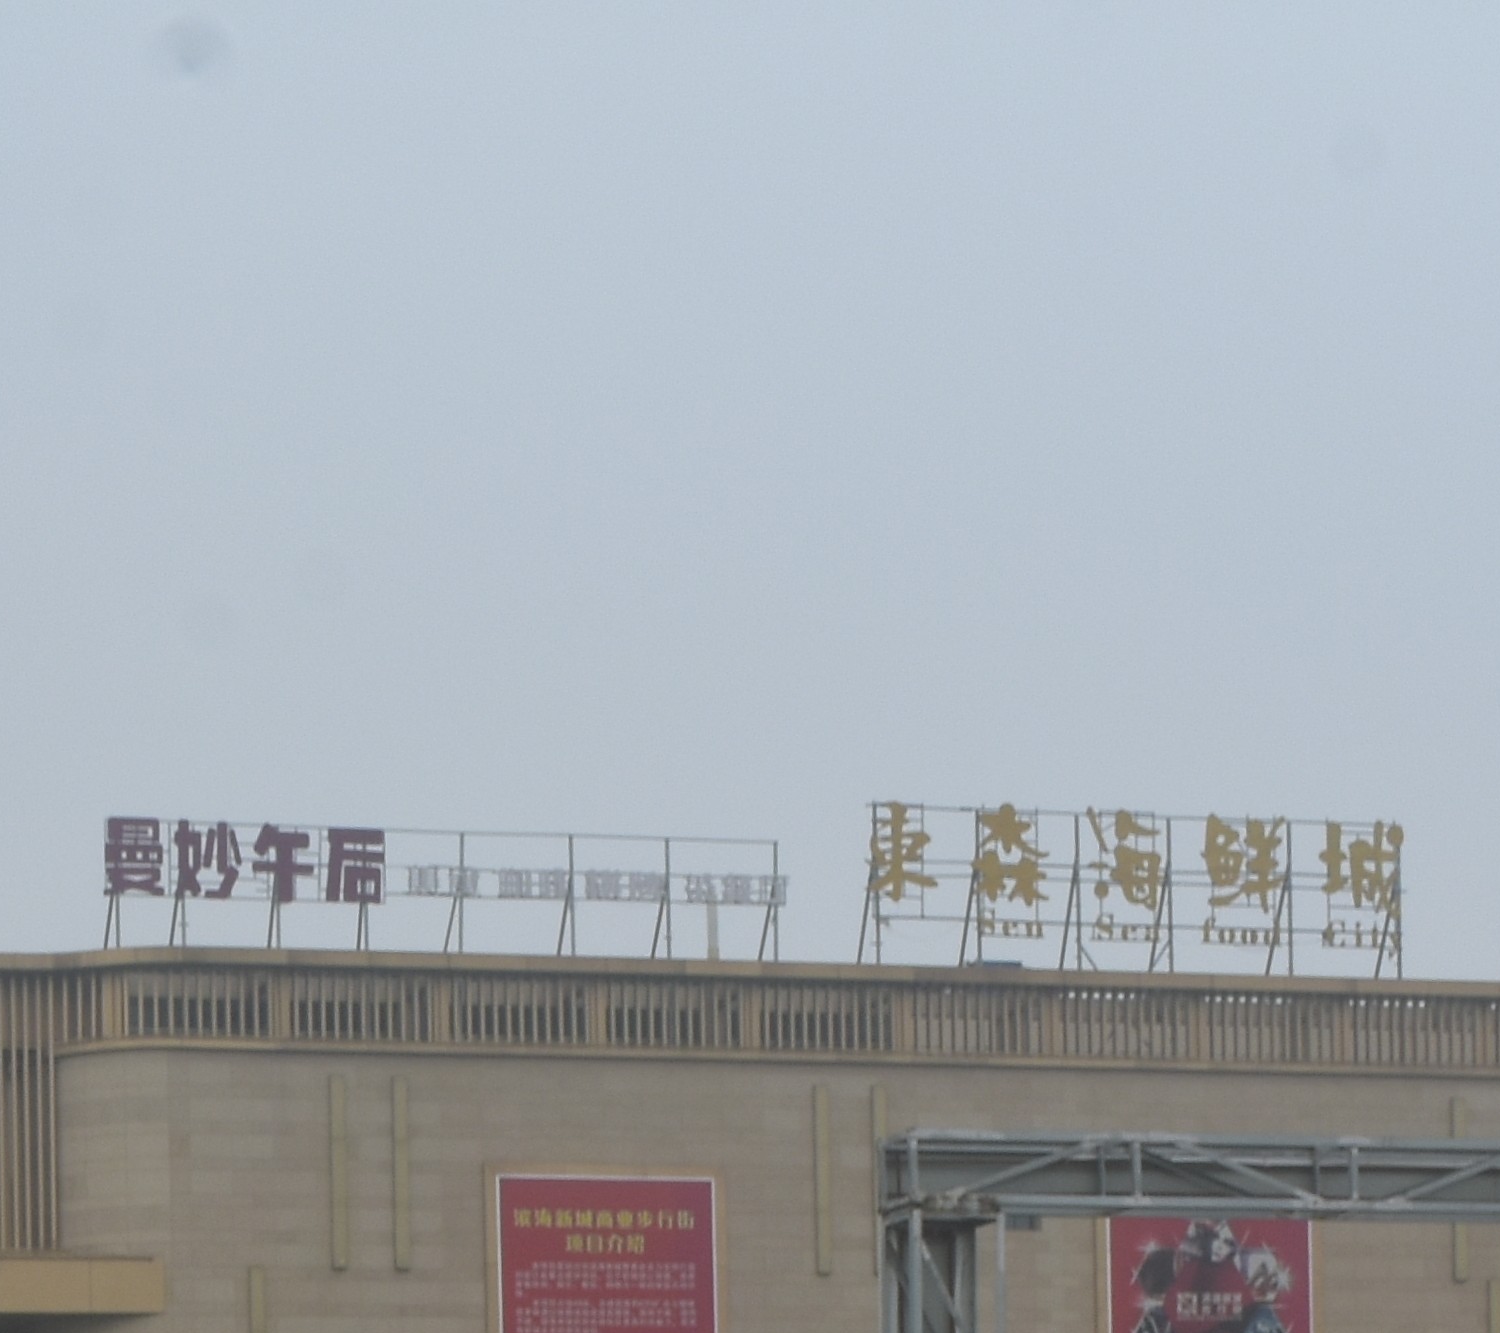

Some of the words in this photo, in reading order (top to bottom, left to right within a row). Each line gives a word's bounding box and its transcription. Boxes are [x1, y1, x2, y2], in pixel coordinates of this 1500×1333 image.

[103, 816, 386, 903] 曼妙午后
[1321, 919, 1400, 956] City
[513, 1207, 696, 1231] 滨海新城商业步行街
[565, 1232, 646, 1255] 项目介绍
